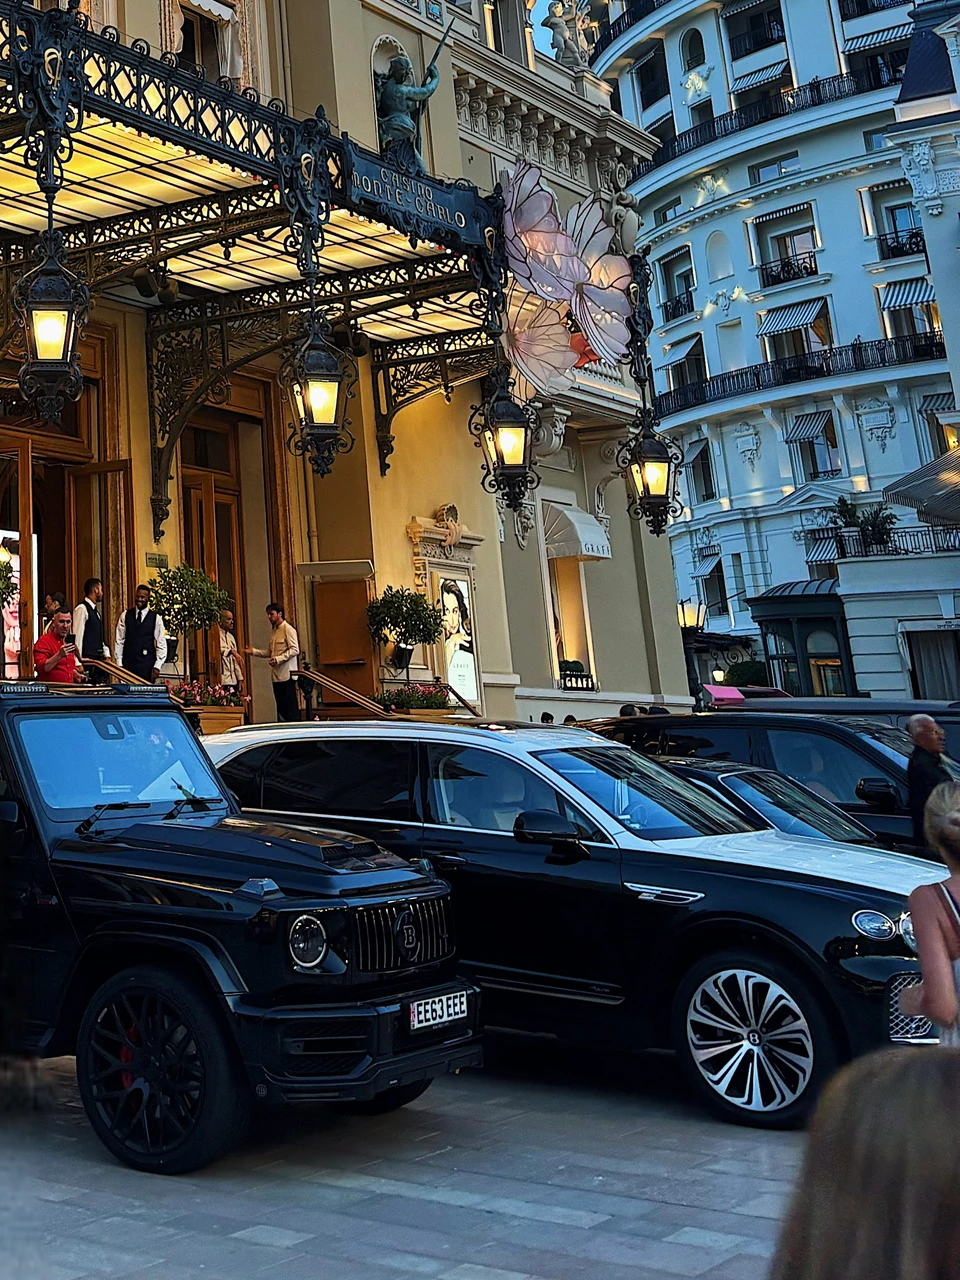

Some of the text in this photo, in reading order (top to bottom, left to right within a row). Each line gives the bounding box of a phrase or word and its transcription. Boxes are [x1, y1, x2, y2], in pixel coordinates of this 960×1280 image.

[351, 169, 466, 228] MONTE-CARLO
[380, 168, 433, 201] CASINO
[584, 542, 610, 555] GRAFF
[565, 676, 592, 688] GRAFF
[416, 993, 466, 1025] EE63 EEE
